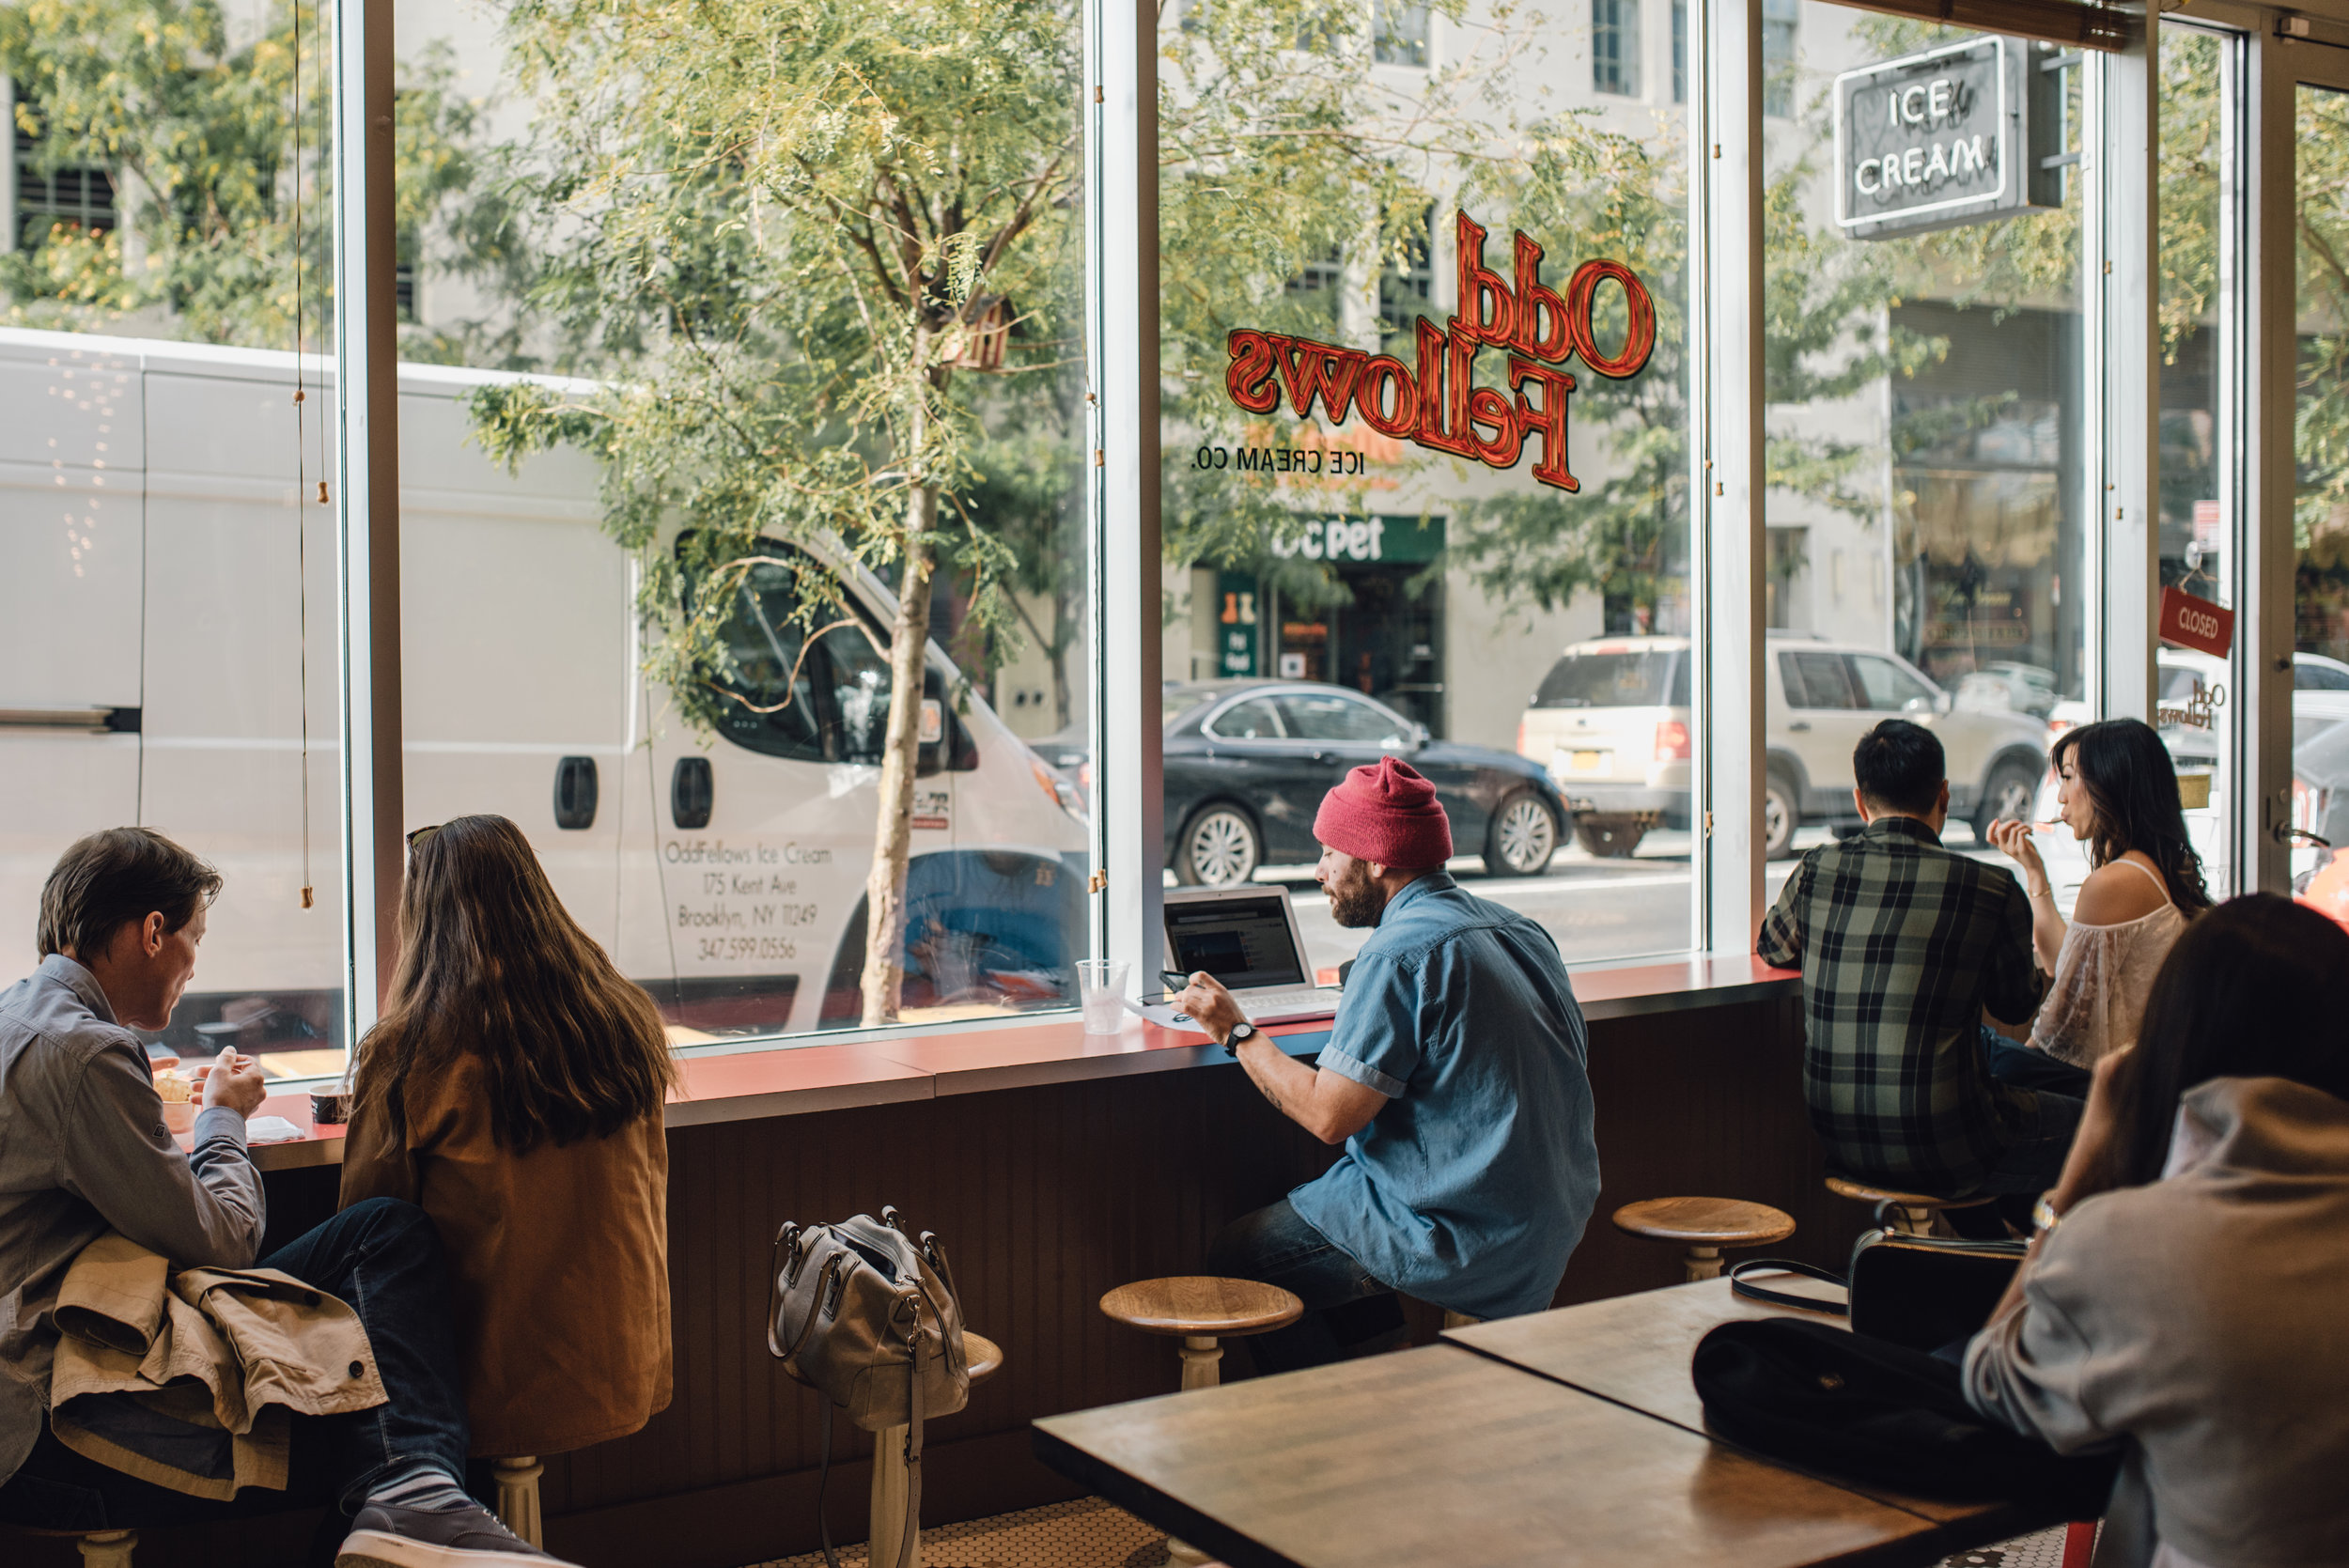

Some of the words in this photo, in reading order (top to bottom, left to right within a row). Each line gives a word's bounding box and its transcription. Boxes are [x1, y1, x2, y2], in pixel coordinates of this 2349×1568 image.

[1889, 79, 1951, 126] ICE
[1855, 134, 1985, 194] CREAM
[2179, 606, 2219, 640] CLOSED
[665, 840, 751, 864] OddFellows
[757, 842, 778, 864] Ice
[785, 841, 833, 864] Cream
[704, 873, 725, 894] 175
[732, 873, 764, 895] Kent
[770, 874, 797, 894] Ave
[678, 903, 747, 930] Brooklyn,
[753, 905, 776, 926] NY
